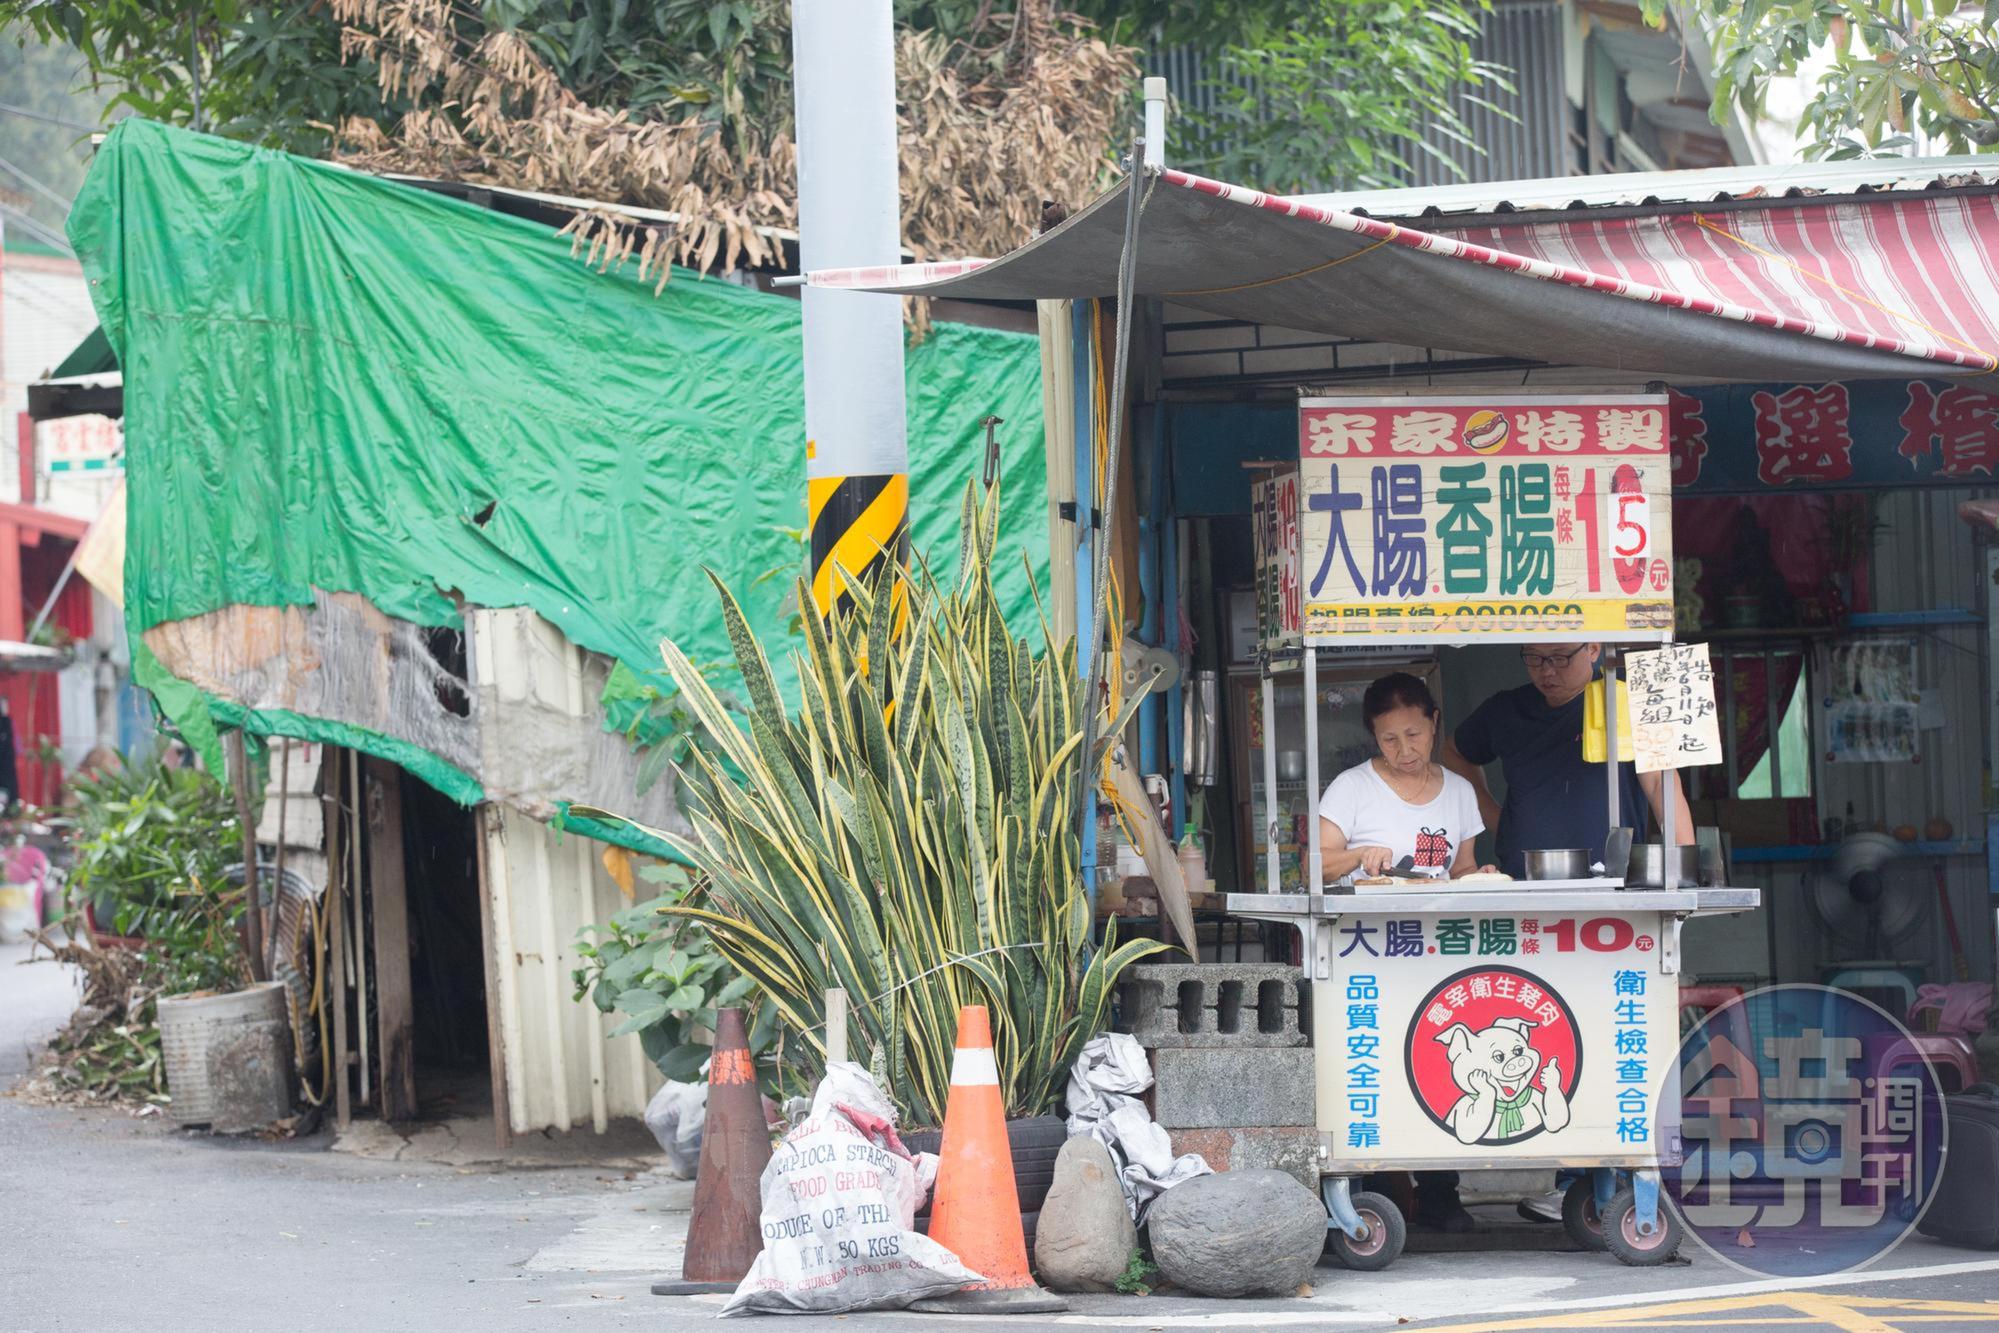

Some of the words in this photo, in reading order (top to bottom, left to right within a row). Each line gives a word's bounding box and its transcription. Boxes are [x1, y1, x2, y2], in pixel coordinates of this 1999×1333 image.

[1553, 465, 1574, 546] 每條
[1651, 560, 1669, 590] 元
[1520, 918, 1541, 955] 每條
[1543, 917, 1634, 953] 10
[1636, 936, 1654, 952] 元
[1426, 976, 1560, 1029] 電宰衛生豬肉
[1346, 974, 1380, 1148] 品質安全可靠
[1613, 969, 1650, 1144] 衛生檢查合格
[790, 1176, 827, 1200] FOOD
[822, 1207, 845, 1229] OF
[839, 1240, 858, 1259] 50
[868, 1236, 899, 1258] KGS
[853, 1261, 902, 1276] TRADING
